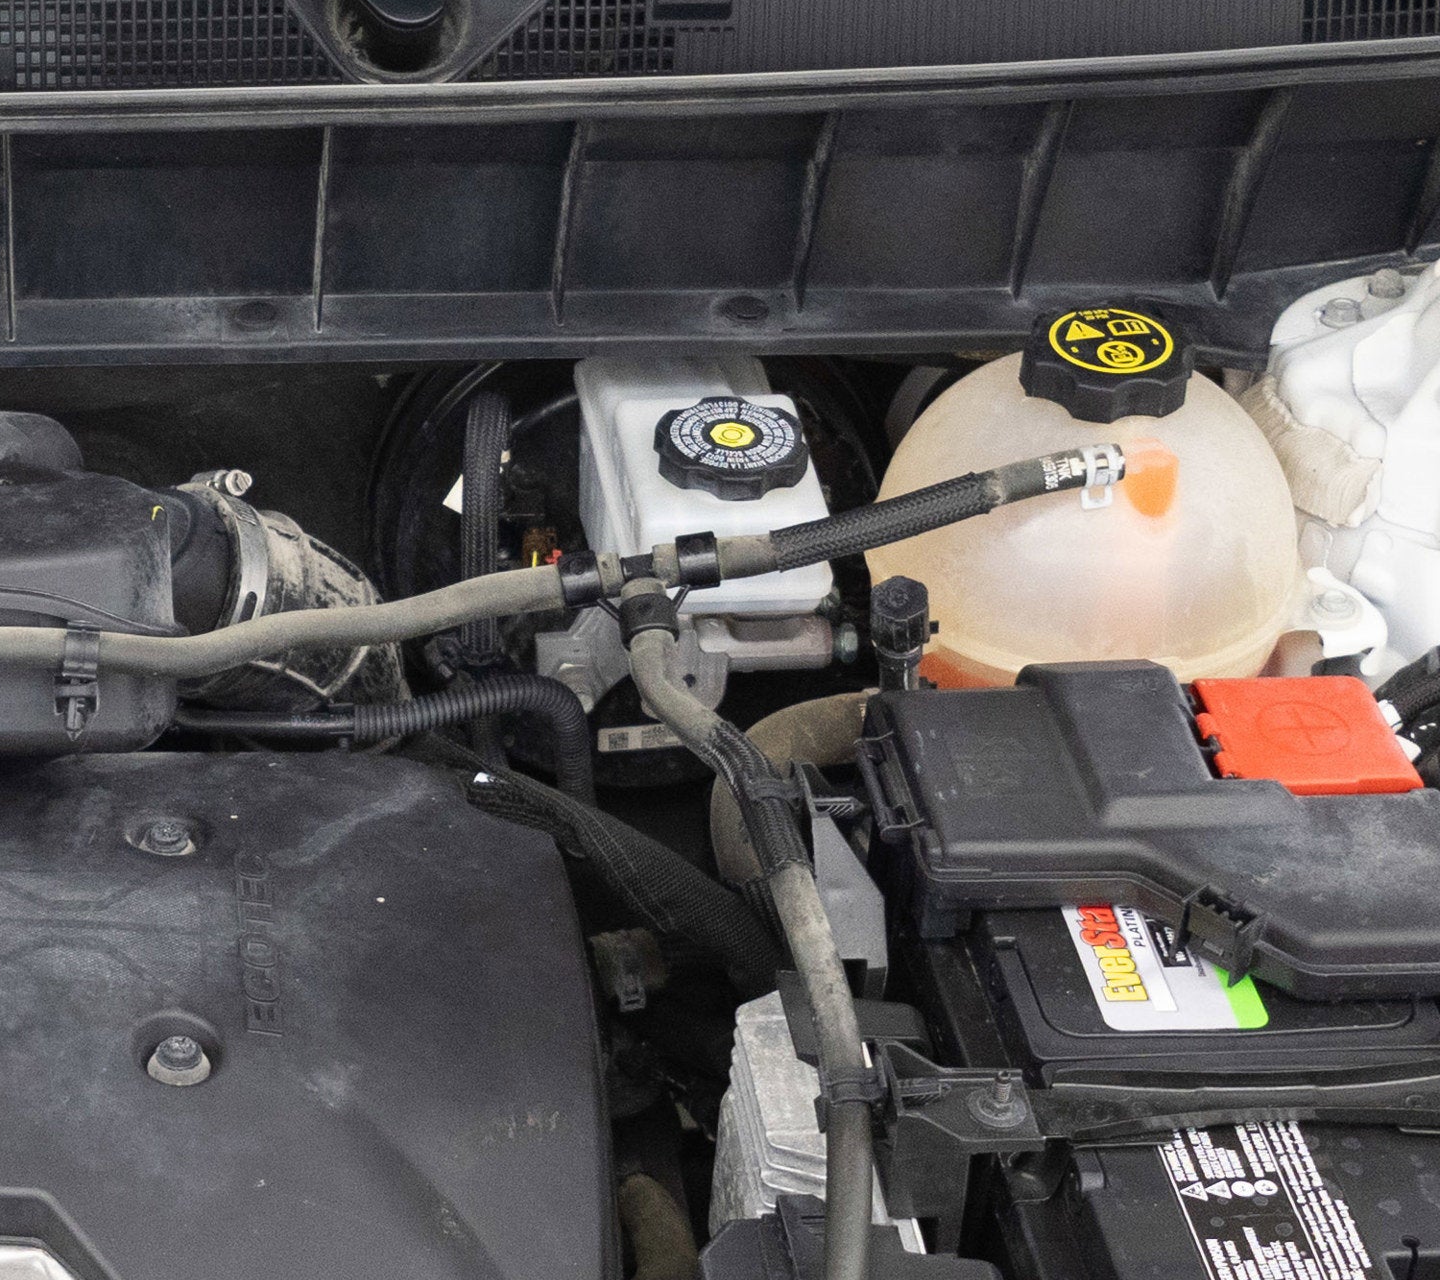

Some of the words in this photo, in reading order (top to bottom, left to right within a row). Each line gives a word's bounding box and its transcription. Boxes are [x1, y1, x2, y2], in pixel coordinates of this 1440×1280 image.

[1055, 457, 1072, 481] TNK
[1120, 906, 1146, 948] PLATIN
[1076, 904, 1149, 1002] EverSta
